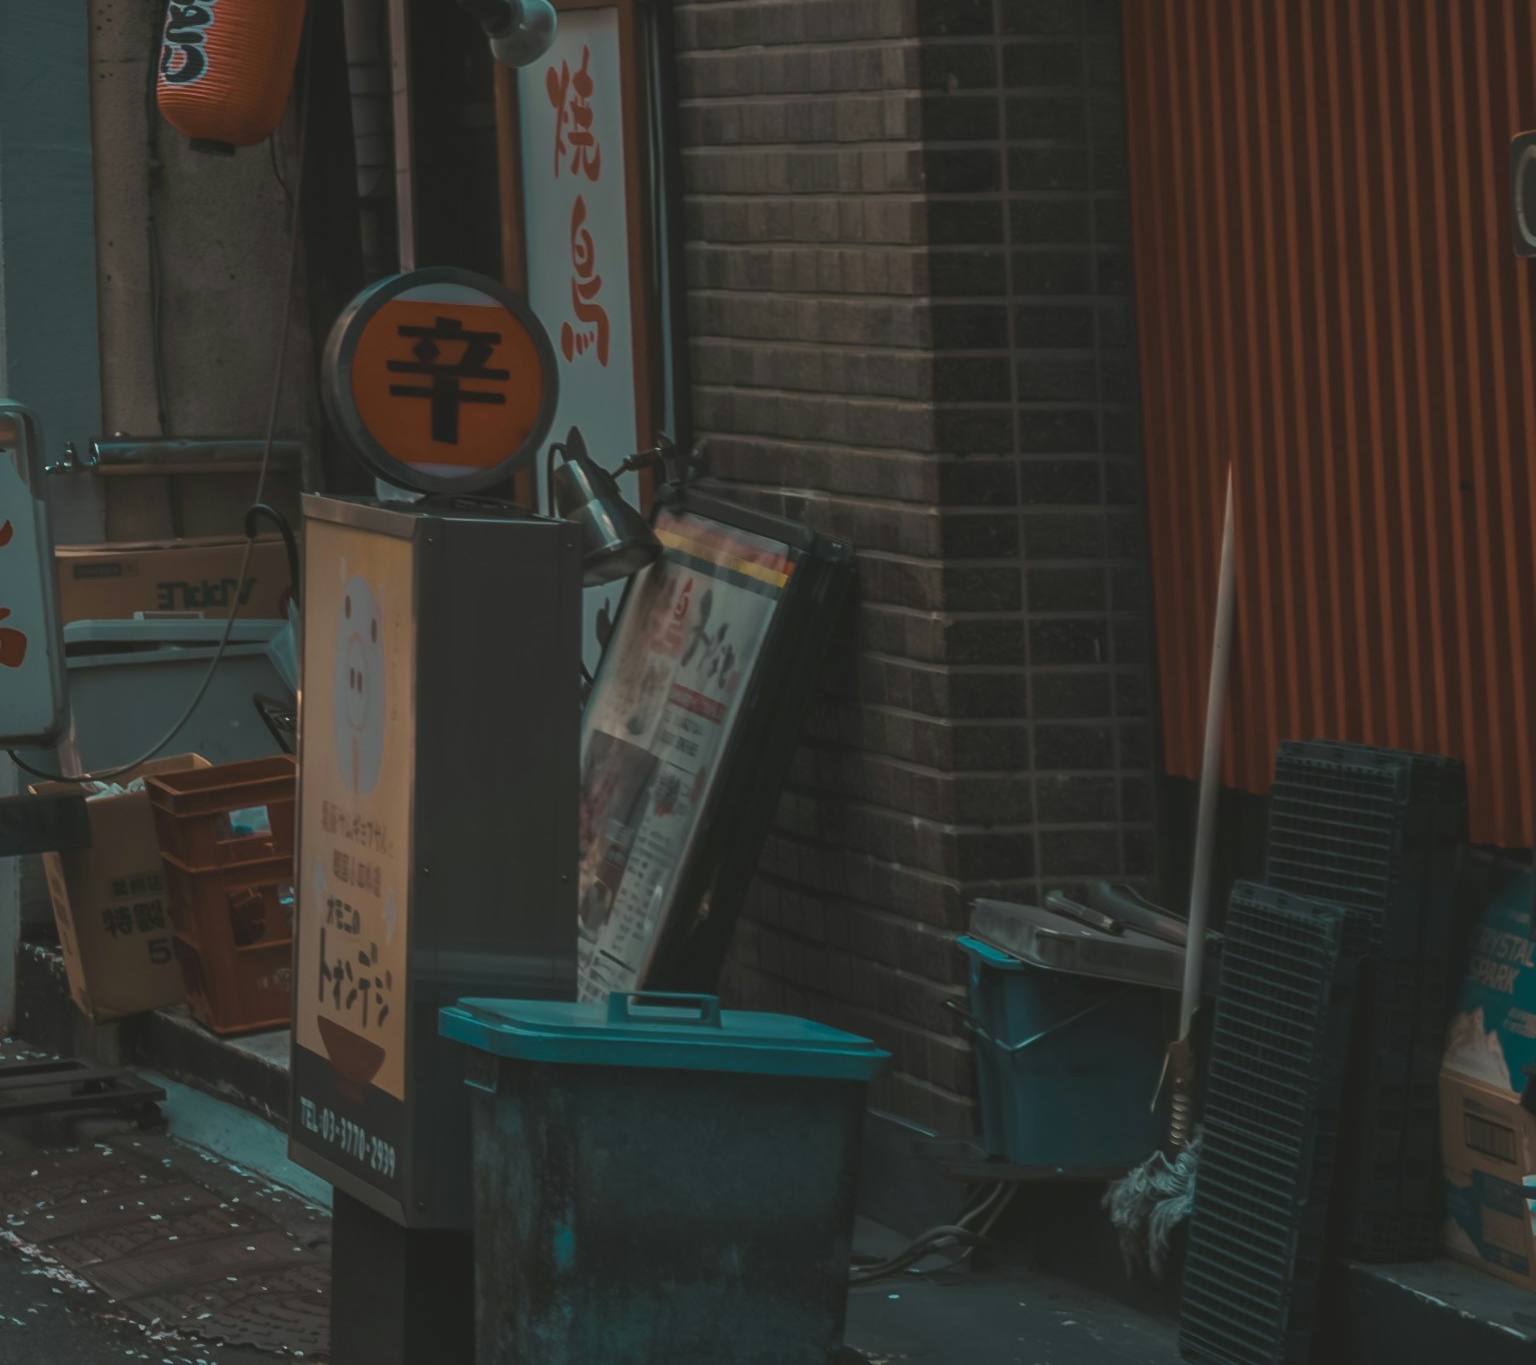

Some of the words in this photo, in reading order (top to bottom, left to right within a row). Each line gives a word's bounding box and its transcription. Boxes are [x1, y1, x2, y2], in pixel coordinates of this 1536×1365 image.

[544, 43, 612, 369] 焼鳥
[385, 315, 511, 445] 辛
[147, 937, 173, 965] 5
